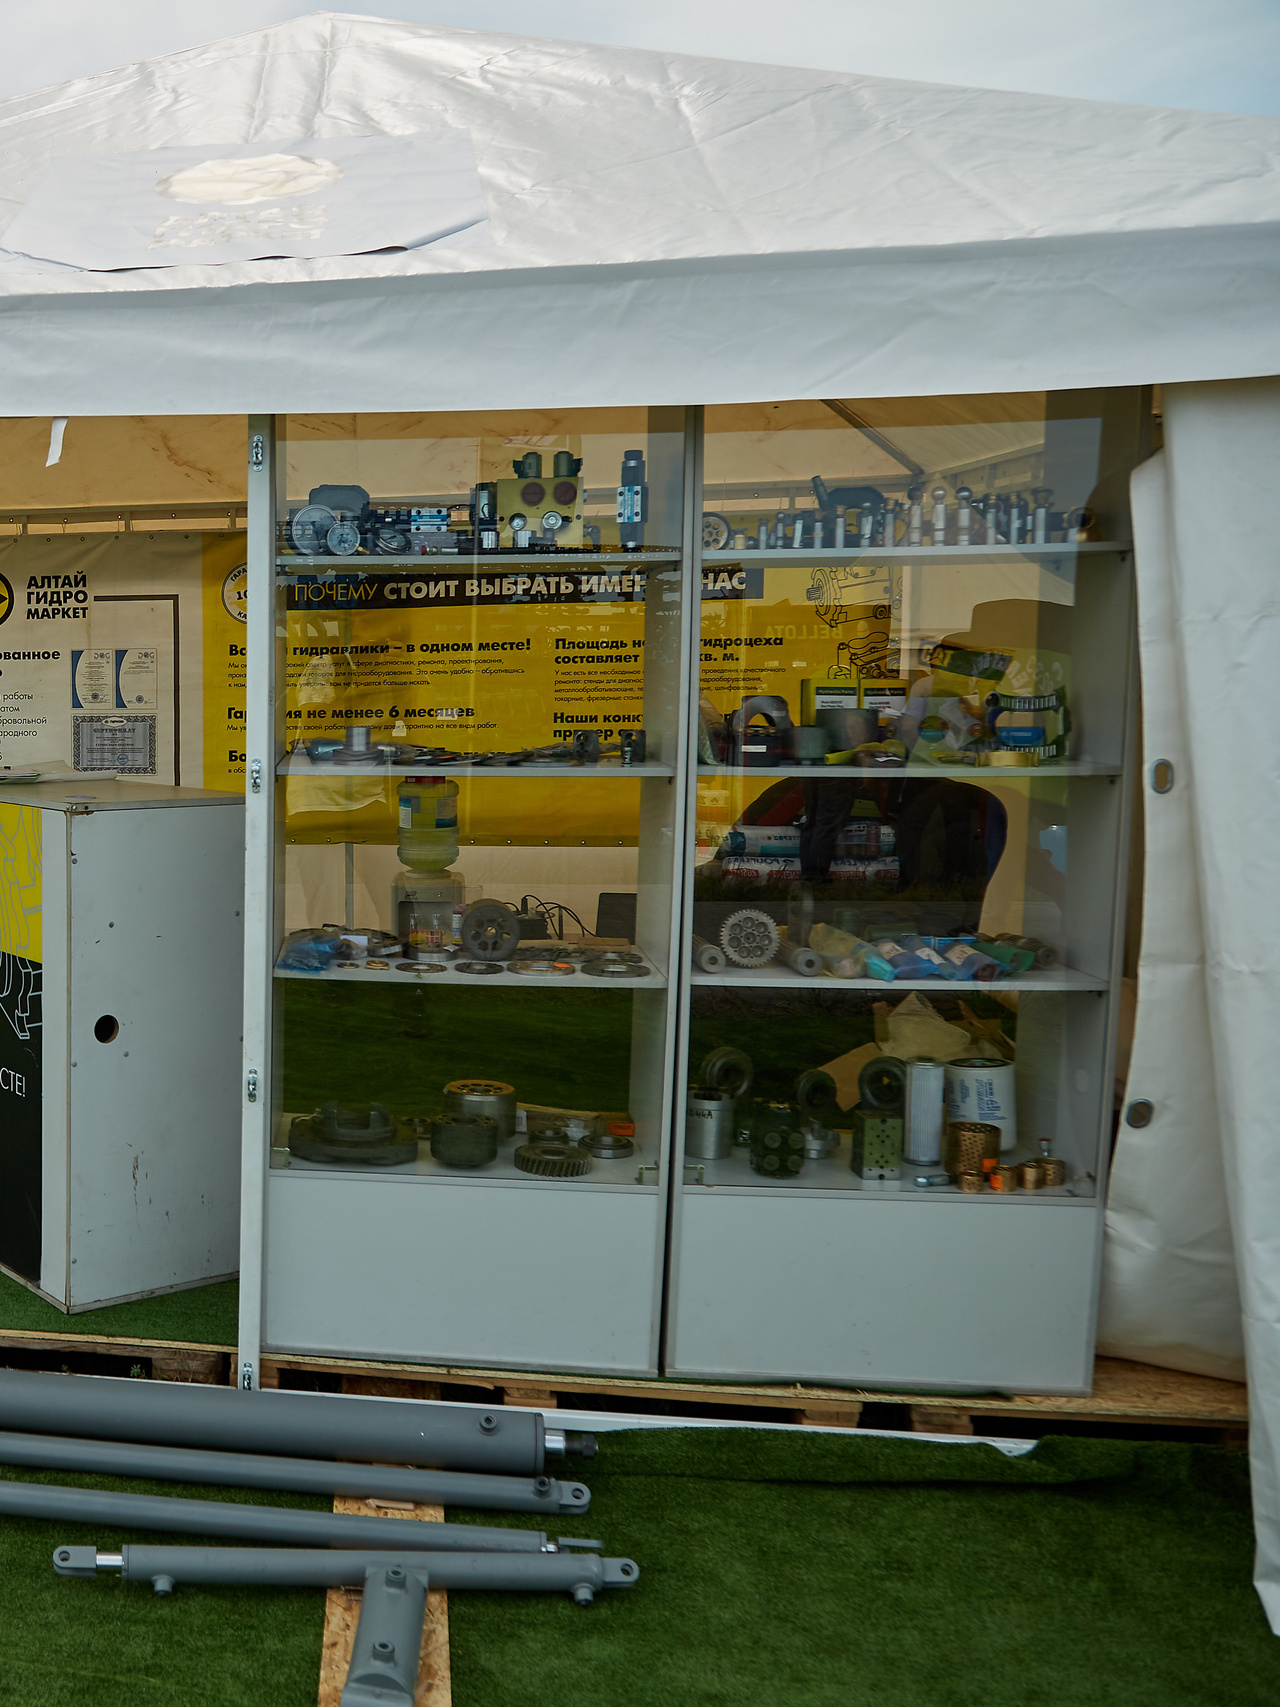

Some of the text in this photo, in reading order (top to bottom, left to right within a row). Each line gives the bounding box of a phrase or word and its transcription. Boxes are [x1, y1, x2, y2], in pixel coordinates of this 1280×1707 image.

[26, 570, 87, 589] АЛТАЙ
[295, 582, 379, 602] ПОЧЕМУ
[384, 579, 460, 600] СТОИТ
[465, 576, 574, 597] ВЫБРАТЬ
[581, 574, 646, 593] ИМЕН
[26, 590, 88, 606] ГИДРО
[26, 607, 88, 620] МАРКЕТ
[293, 643, 389, 658] гидравлики
[406, 643, 415, 652] в
[420, 641, 473, 653] одном
[478, 638, 531, 651] месте!
[555, 638, 628, 650] Площадь
[554, 654, 640, 664] составляет
[722, 653, 740, 661] м.
[700, 676, 763, 684] идрооборудования,
[3, 691, 34, 702] работы
[307, 709, 327, 719] не
[331, 708, 384, 719] менее
[388, 705, 400, 718] 6
[404, 706, 475, 719] месяцев
[553, 712, 598, 723] Наши
